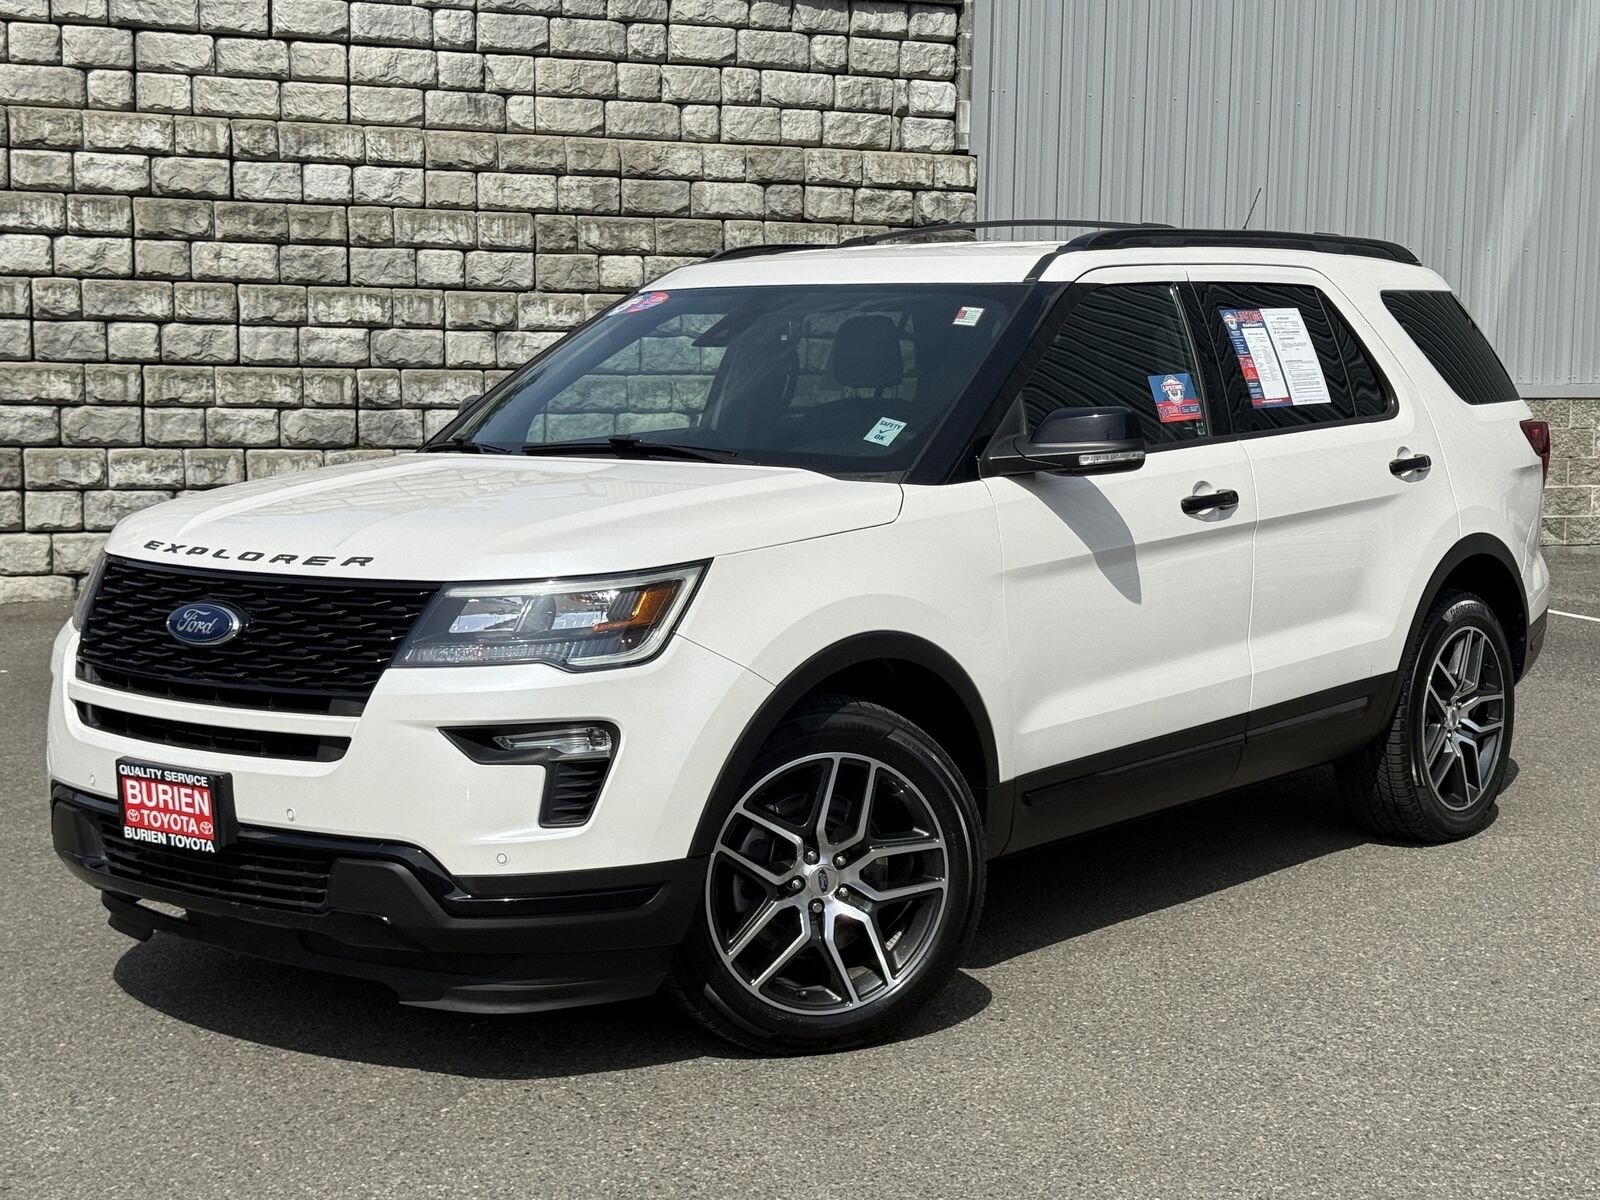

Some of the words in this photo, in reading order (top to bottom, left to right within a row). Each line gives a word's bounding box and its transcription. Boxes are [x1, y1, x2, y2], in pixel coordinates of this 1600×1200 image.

[880, 420, 902, 430] SAFETY
[143, 540, 374, 567] EXPLORER
[176, 608, 217, 635] Ford
[119, 764, 162, 780] QUALITY
[164, 771, 208, 787] SERVICE
[125, 780, 210, 816] BURIEN
[140, 810, 199, 835] TOYOTA
[124, 826, 167, 844] BURIEN
[168, 834, 215, 853] TOYOTA
